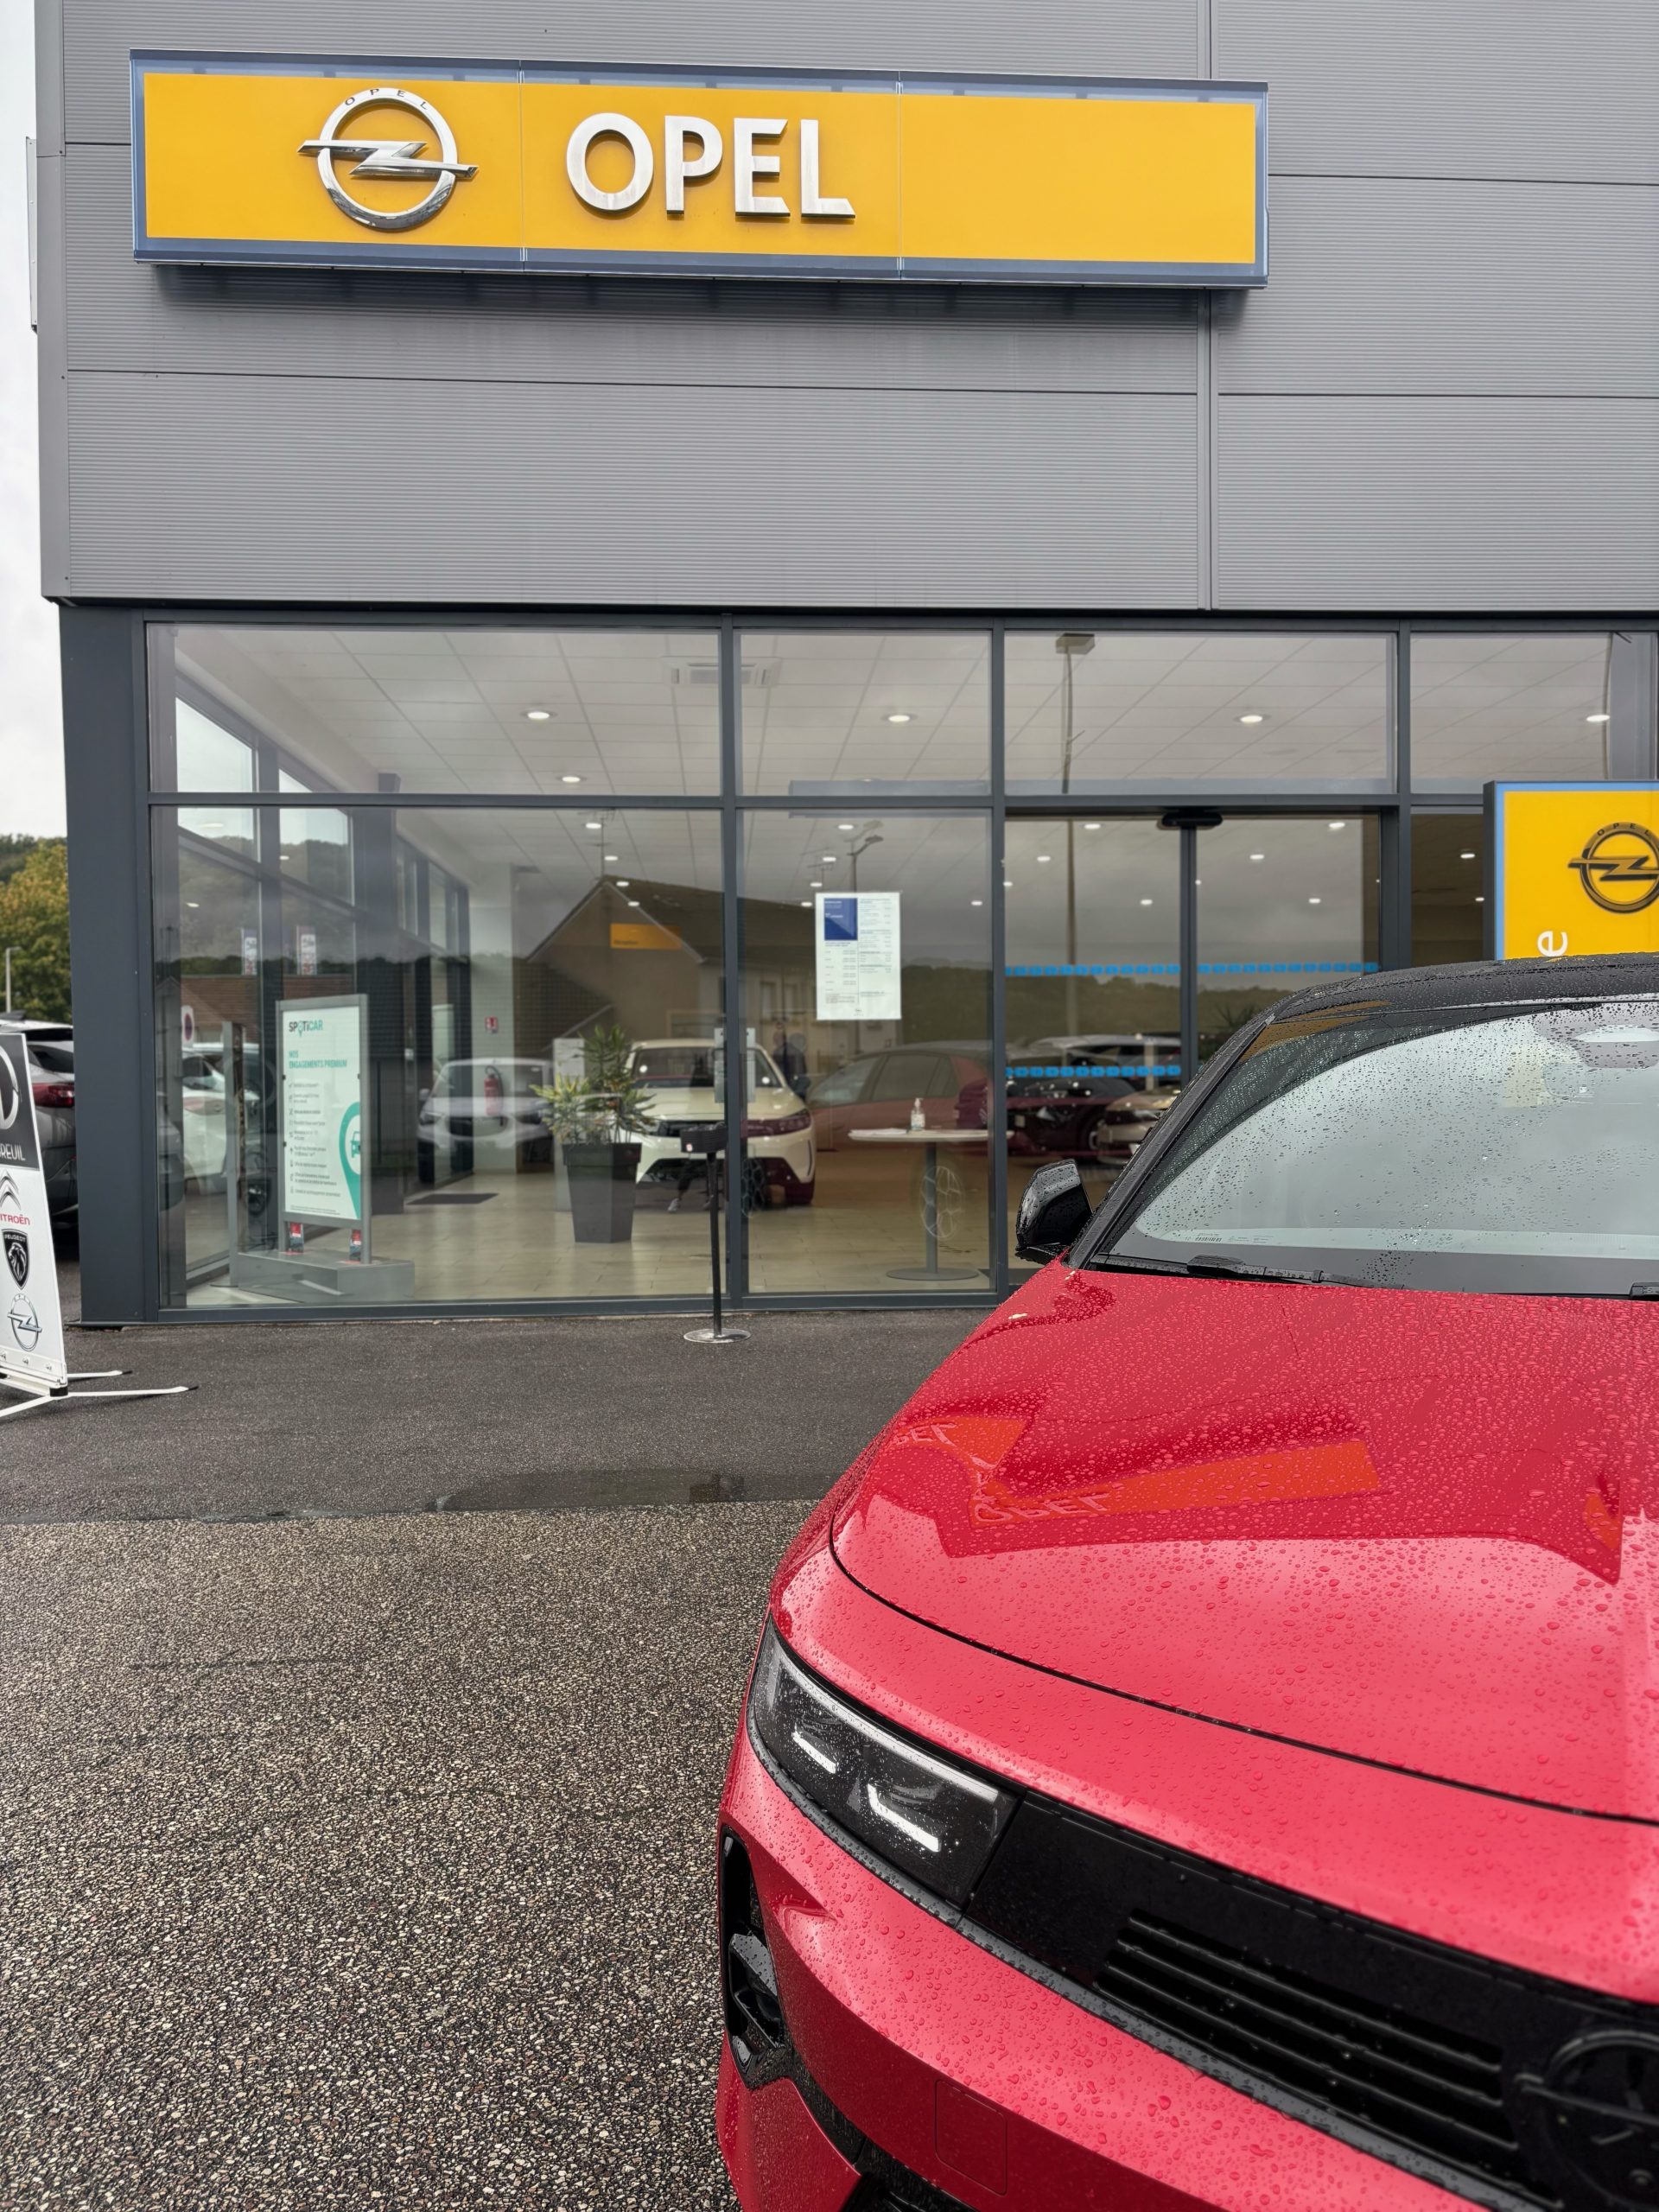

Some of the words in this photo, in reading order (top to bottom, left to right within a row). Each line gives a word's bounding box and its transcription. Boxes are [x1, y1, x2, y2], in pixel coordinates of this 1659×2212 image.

[345, 88, 429, 111] OPEL
[566, 112, 856, 219] OPEL
[1597, 822, 1651, 836] OPEL
[0, 1143, 26, 1161] REUIL
[0, 1213, 30, 1225] ITROËN
[4, 1233, 27, 1243] PEUGEOT
